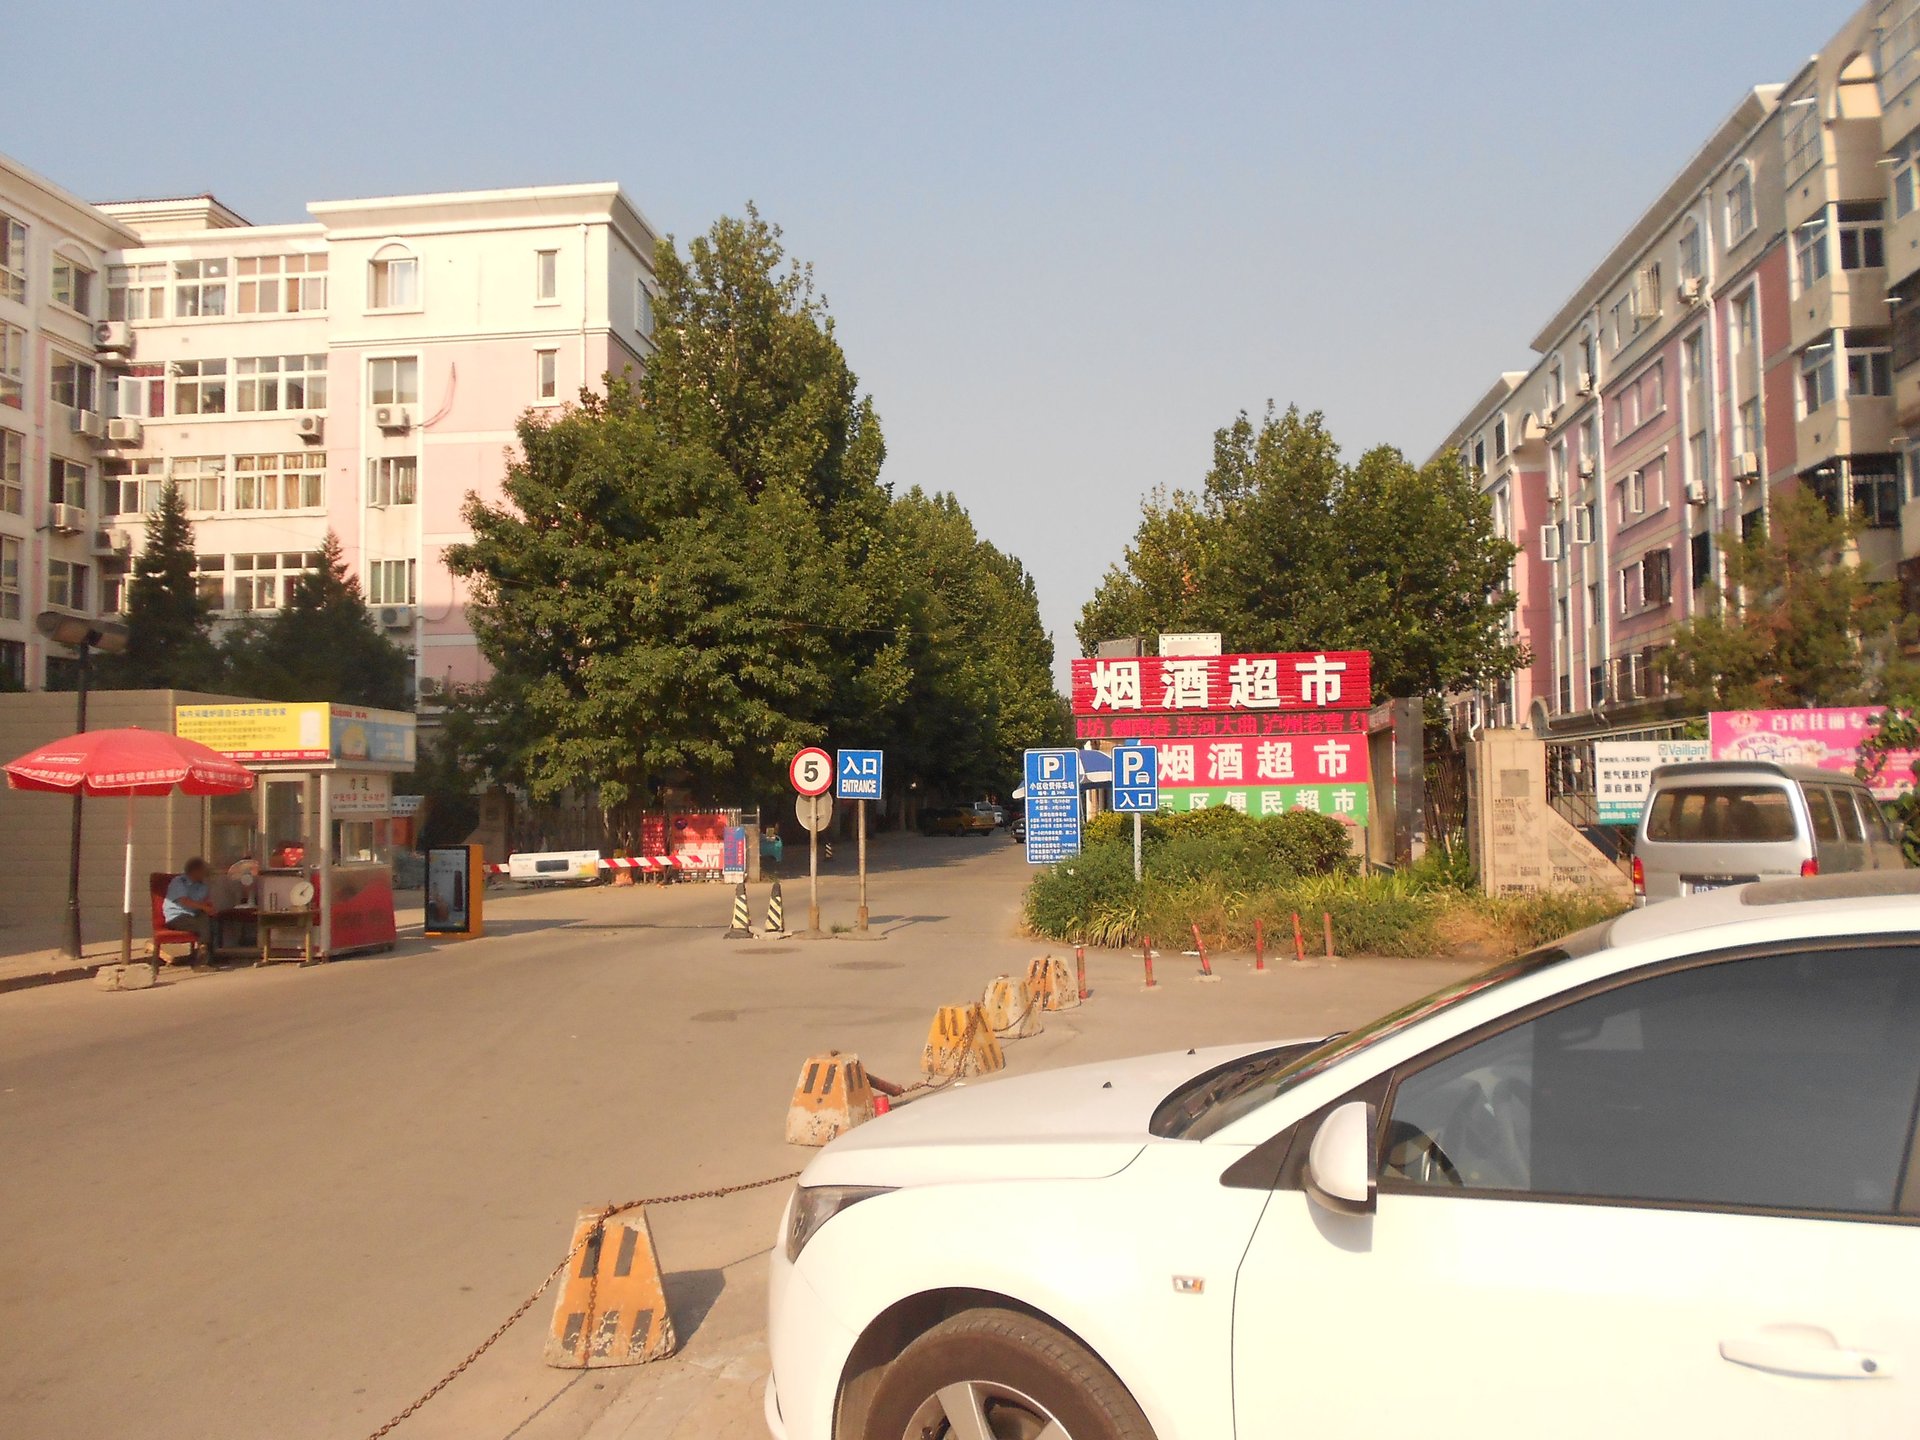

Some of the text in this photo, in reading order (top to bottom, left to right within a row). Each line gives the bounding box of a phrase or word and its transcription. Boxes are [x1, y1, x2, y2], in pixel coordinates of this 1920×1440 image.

[1091, 655, 1346, 711] 烟酒超市
[1177, 714, 1258, 736] 洋河大曲
[1263, 712, 1344, 735] 泸州老窖
[1159, 739, 1351, 781] 烟酒超市
[1668, 743, 1708, 757] Vaillant
[804, 760, 819, 782] 5
[842, 756, 877, 775] 入口
[1043, 756, 1060, 779] P
[1122, 751, 1144, 785] P
[841, 779, 877, 793] ENTRANCE
[1604, 783, 1643, 793] 源自德国
[1119, 792, 1152, 808] 入口
